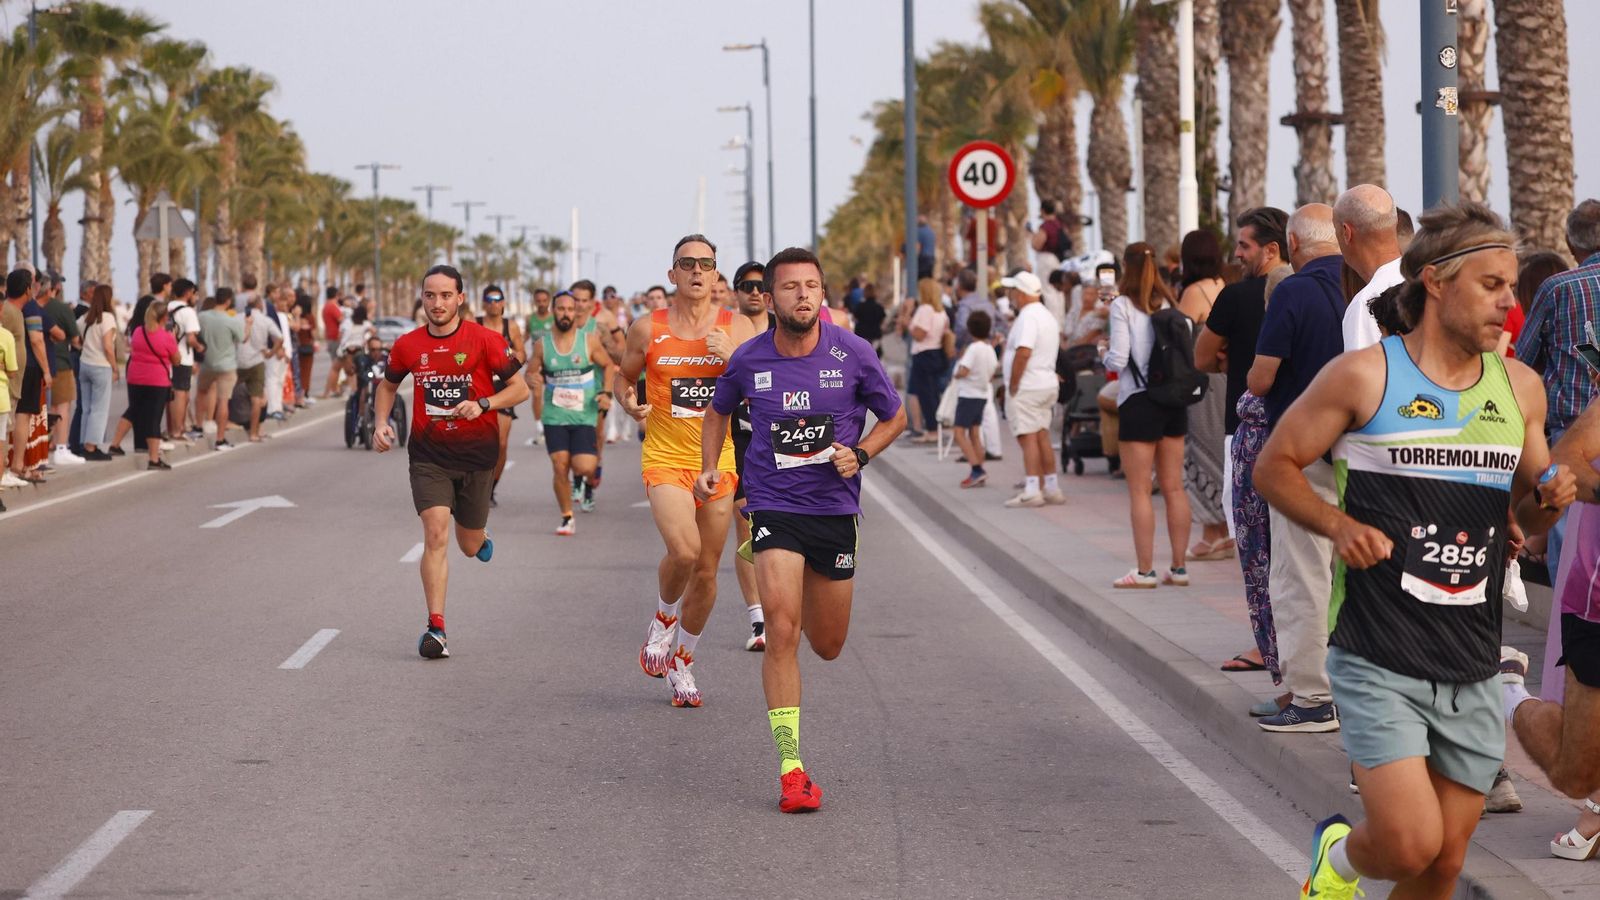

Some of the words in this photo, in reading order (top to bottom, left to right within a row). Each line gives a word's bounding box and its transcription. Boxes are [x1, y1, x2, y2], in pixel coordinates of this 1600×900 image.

[963, 162, 997, 186] 40
[657, 355, 723, 366] ESPAÑA
[829, 346, 848, 360] EA7
[431, 388, 461, 398] 1065
[680, 386, 716, 398] 2602
[783, 391, 811, 406] DKR
[780, 425, 826, 443] 2467
[1388, 447, 1518, 472] TORREMOLINOS
[1422, 541, 1488, 567] 2856
